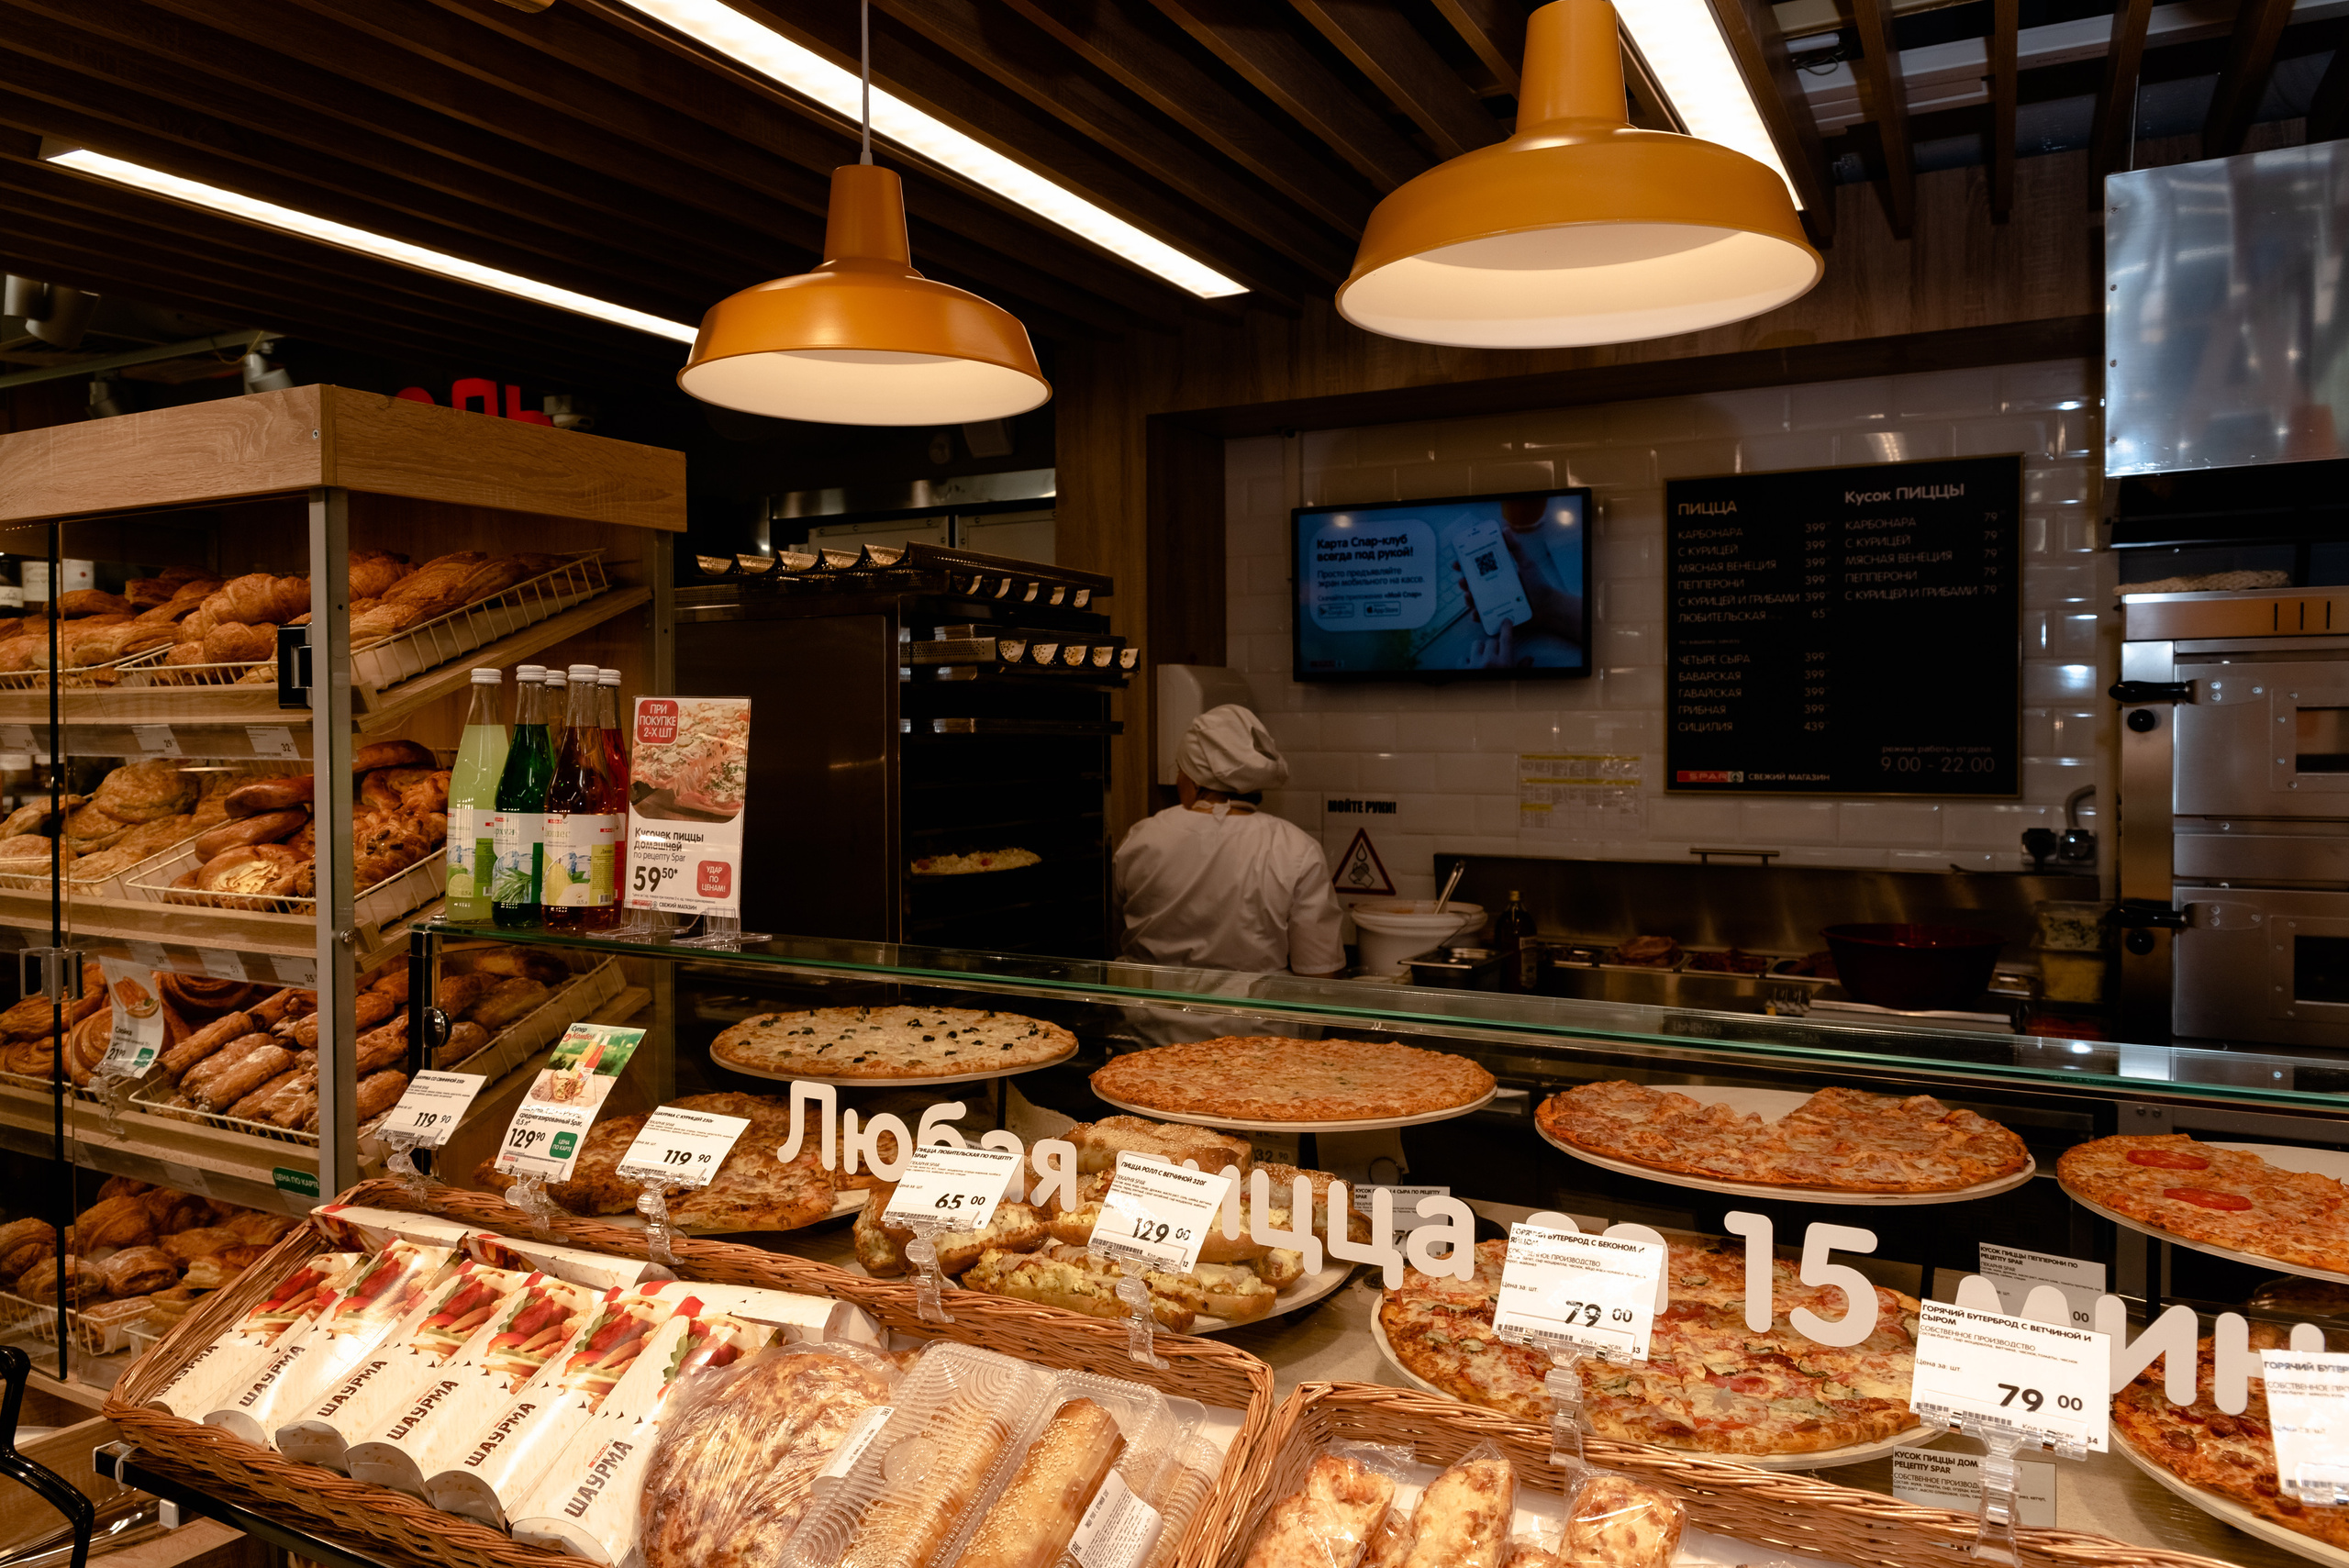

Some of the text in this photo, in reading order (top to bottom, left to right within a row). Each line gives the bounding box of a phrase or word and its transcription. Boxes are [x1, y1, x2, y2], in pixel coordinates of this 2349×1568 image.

[1844, 483, 1965, 506] Кусок ПИЦЦЫ
[1677, 500, 1738, 517] ПИЦЦА
[1844, 511, 1998, 531] КАРБОНАРА 79
[1677, 522, 1826, 539] КАРБОНАРА 399
[1317, 534, 1408, 550] Карта Спар-клуб
[1844, 530, 1998, 549] С КУРИЦЕЙ 79
[1317, 546, 1413, 562] всегда под рукой!
[1677, 539, 1826, 557] С КУРИЦЕЙ 399
[1677, 557, 1826, 573] МЯСНАЯ ВЕНЕЦИЯ 399
[1844, 548, 1998, 566] МЯСНАЯ ВЕНЕЦИЯ 79
[1317, 570, 1345, 580] Просто
[1677, 574, 1826, 590] ПЕППЕРОНИ 399
[1844, 566, 1998, 584] ПЕППЕРОНИ 79
[1677, 592, 1826, 607] С КУРИЦЕЙ И ГРИБАМИ 399
[1844, 584, 1997, 602] С КУРИЦЕЙ И ГРИБАМИ 79
[1677, 608, 1826, 623] ЛЮБИТЕЛЬСКАЯ 65
[1678, 651, 1825, 665] ЧЕТЫРЕ СЫРА 399
[1678, 669, 1825, 682] БАВАРСКАЯ 399
[1678, 686, 1825, 699] ГАВАЙСКАЯ 399
[650, 705, 668, 715] ПРИ
[1678, 704, 1825, 716] ГРИБНАЯ 399
[639, 715, 676, 727] ПОКУПКЕ
[1678, 721, 1825, 733] СИЦИЛИЯ 439
[660, 728, 672, 739] ШТ
[1881, 756, 1921, 773] 9.00
[1941, 756, 1996, 773] 22.00
[1748, 771, 1830, 782] СВЕЖИЙ МАГАЗИН
[1328, 798, 1397, 814] МОЙТЕ РУКИ!
[673, 832, 704, 843] пиццы
[633, 851, 686, 862] по рецепту Spar
[707, 866, 723, 874] УДАР
[633, 865, 661, 893] 59
[708, 875, 718, 884] ПО
[701, 883, 726, 893] ЦЕНАМ!
[413, 1112, 451, 1128] 119 90
[508, 1128, 546, 1150] 129 90
[663, 1150, 711, 1166] 119 90
[937, 1149, 980, 1159] ЛЮБИТЕЛЬСКАЯ
[273, 1173, 319, 1189] ЦЕНА ПО КАРТЕ
[1121, 1162, 1141, 1172] ПИЦЦА
[1141, 1167, 1157, 1175] РОЛЛ
[1163, 1172, 1193, 1184] ВЕТЧИНОЙ
[935, 1193, 985, 1210] 65 00
[1132, 1218, 1170, 1243] 129
[1598, 1240, 1637, 1252] БЕКОНОМ
[1980, 1246, 2001, 1255] КУСОК
[2001, 1250, 2027, 1260] ПИЦЦЫ
[2028, 1254, 2067, 1267] ПЕППЕРОНИ
[1980, 1252, 2023, 1266] РЕЦЕПТУ SPAR
[1723, 1210, 1878, 1348] 15
[1564, 1300, 1633, 1328] 79 00
[1921, 1313, 1957, 1326] СЫРОМ
[1922, 1304, 1965, 1318] ГОРЯЧИЙ
[1967, 1312, 2020, 1329] БУТЕРБРОД
[2030, 1325, 2082, 1340] ВЕТЧИНОЙ
[1920, 1324, 2036, 1351] СОБСТВЕННОЕ ПРОИЗВОДСТВО
[2264, 1361, 2314, 1372] ГОРЯЧИЙ
[239, 1345, 306, 1407] ШАУРМА
[317, 1360, 388, 1417] ШАУРМА
[2267, 1381, 2329, 1392] СОБСТВЕННОЕ
[1998, 1383, 2083, 1413] 79 00
[385, 1380, 460, 1440] ШАУРМА
[463, 1402, 537, 1467] ШАУРМА
[1894, 1451, 1921, 1461] КУСОК
[1923, 1454, 1955, 1465] ПИЦЦЫ
[1894, 1461, 1951, 1474] РЕЦЕПТУ SPAR
[563, 1440, 634, 1518] ШАУРМА
[1894, 1472, 1940, 1485] СОБСТВЕННОЕ
